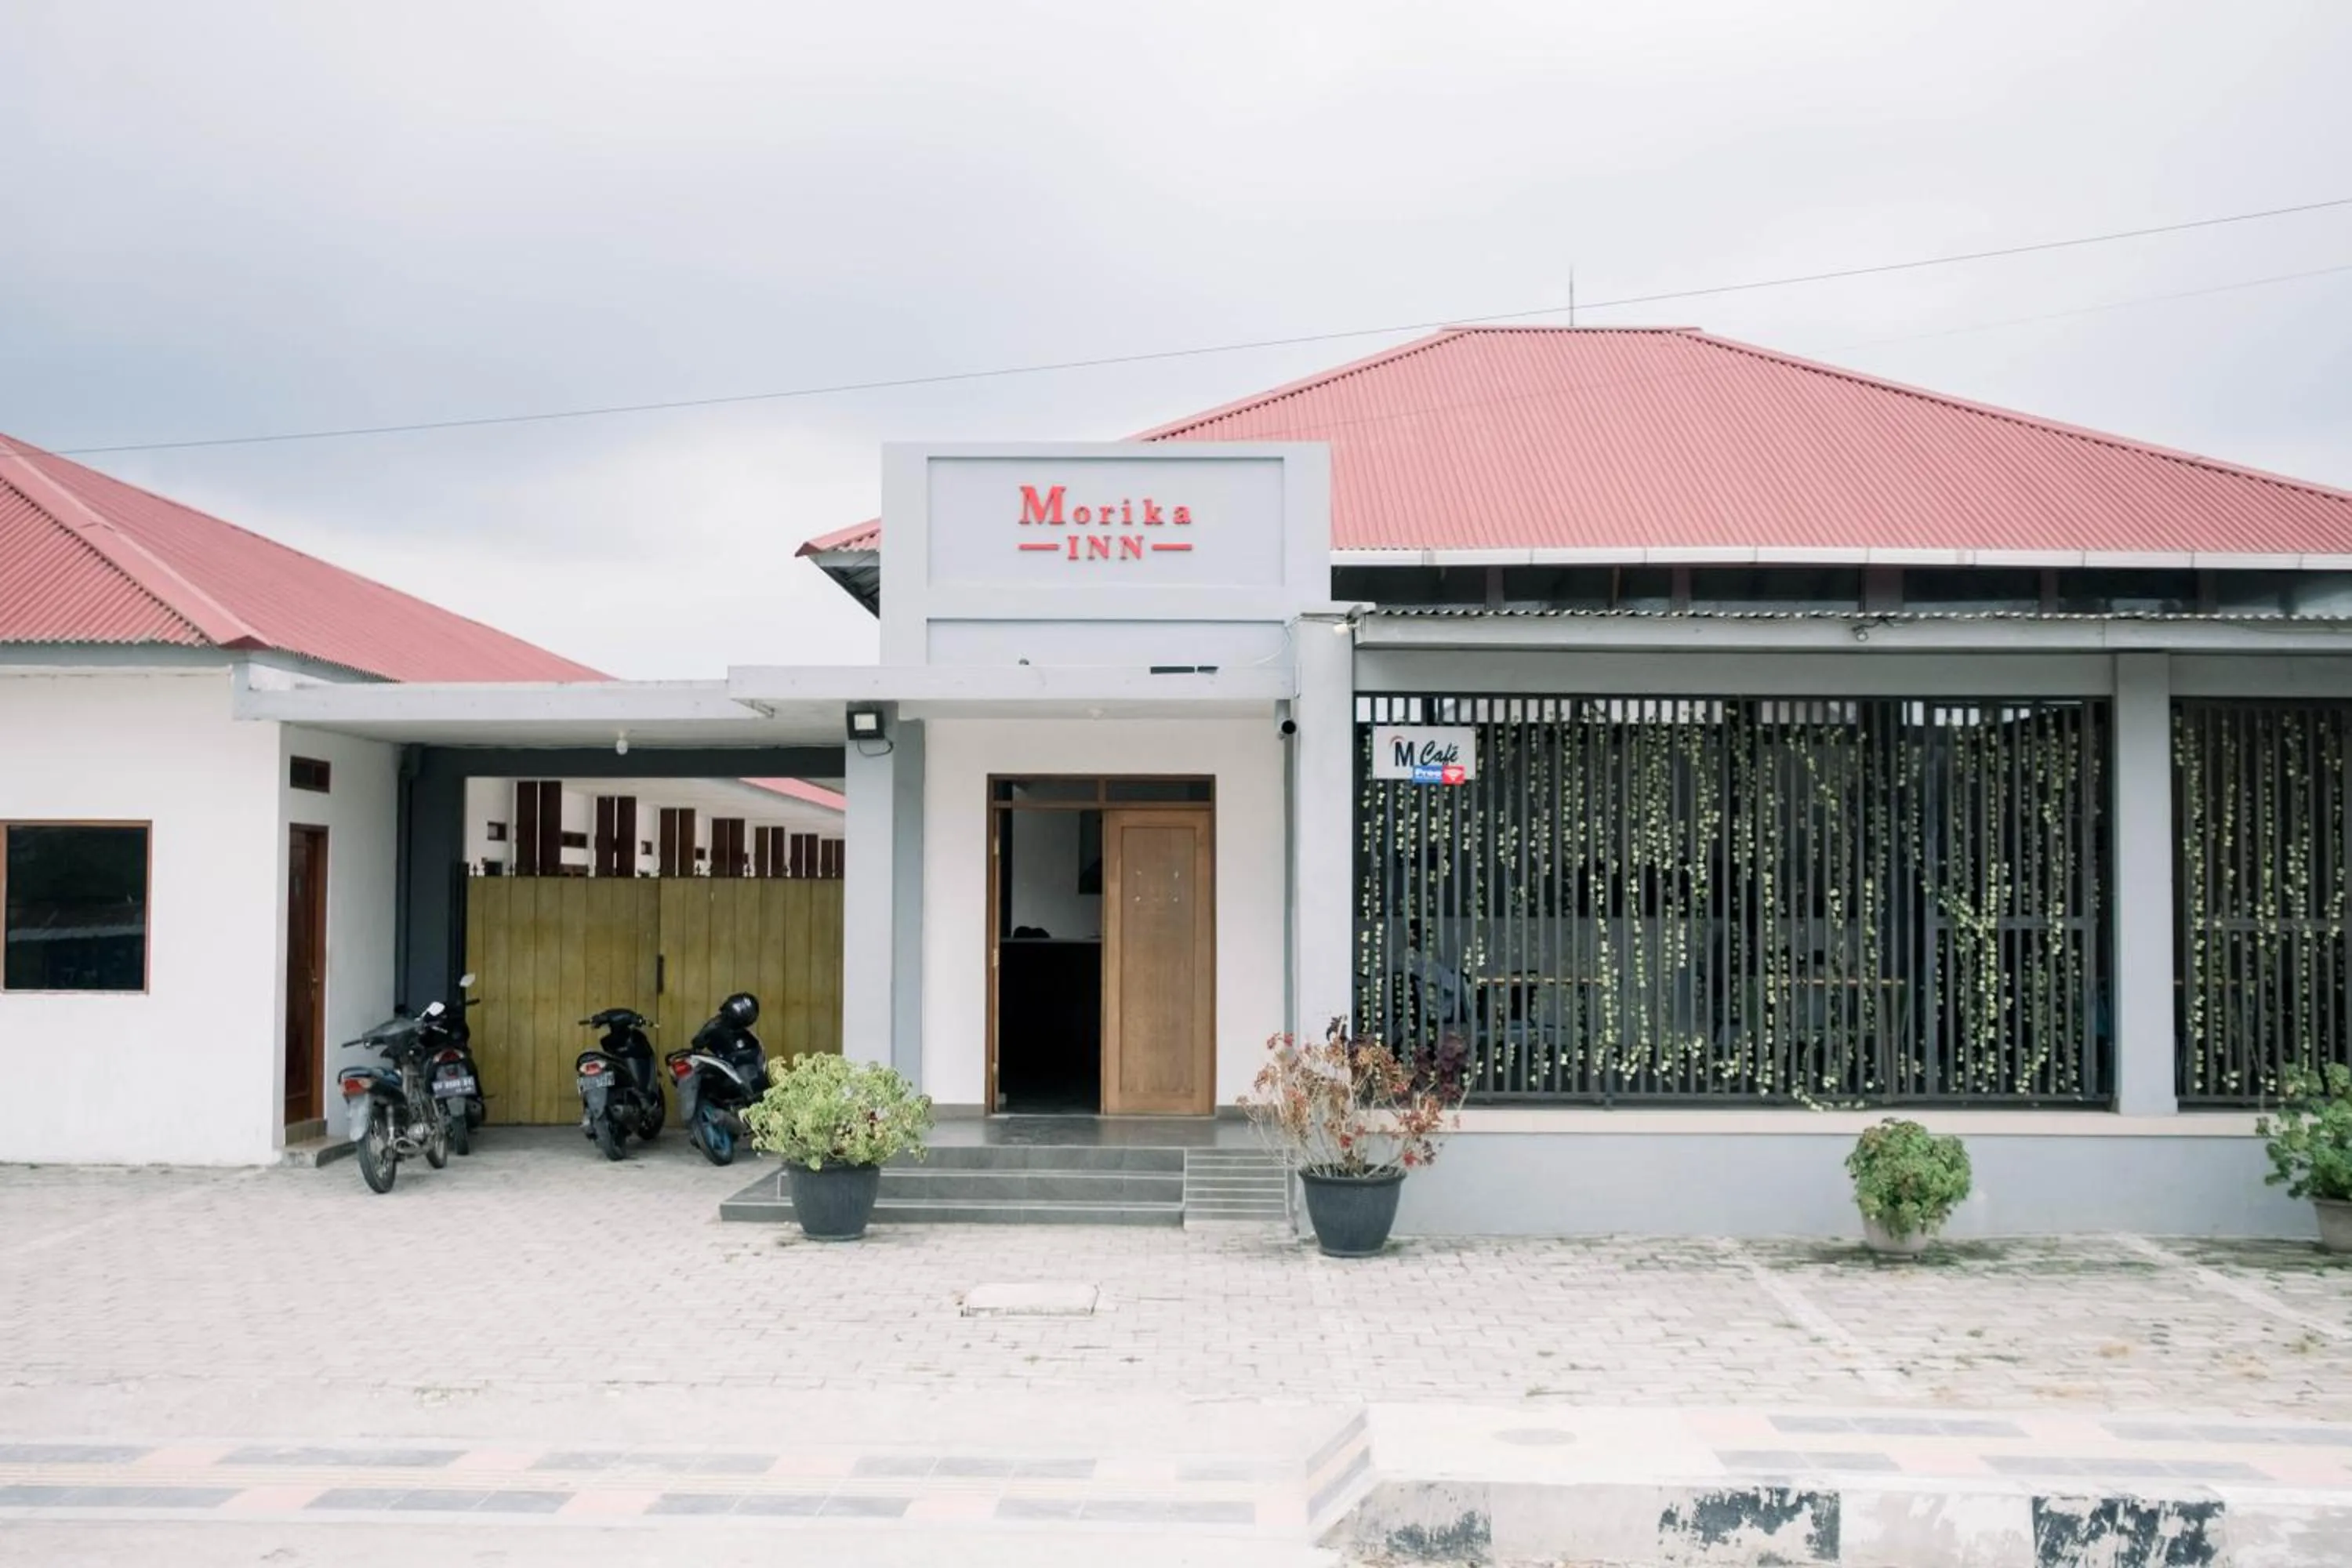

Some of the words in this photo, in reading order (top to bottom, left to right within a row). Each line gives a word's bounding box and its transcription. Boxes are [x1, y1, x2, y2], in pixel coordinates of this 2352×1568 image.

[1018, 485, 1192, 526] Morika
[1067, 535, 1144, 561] INN
[1395, 741, 1414, 767] M
[1420, 740, 1459, 766] Café
